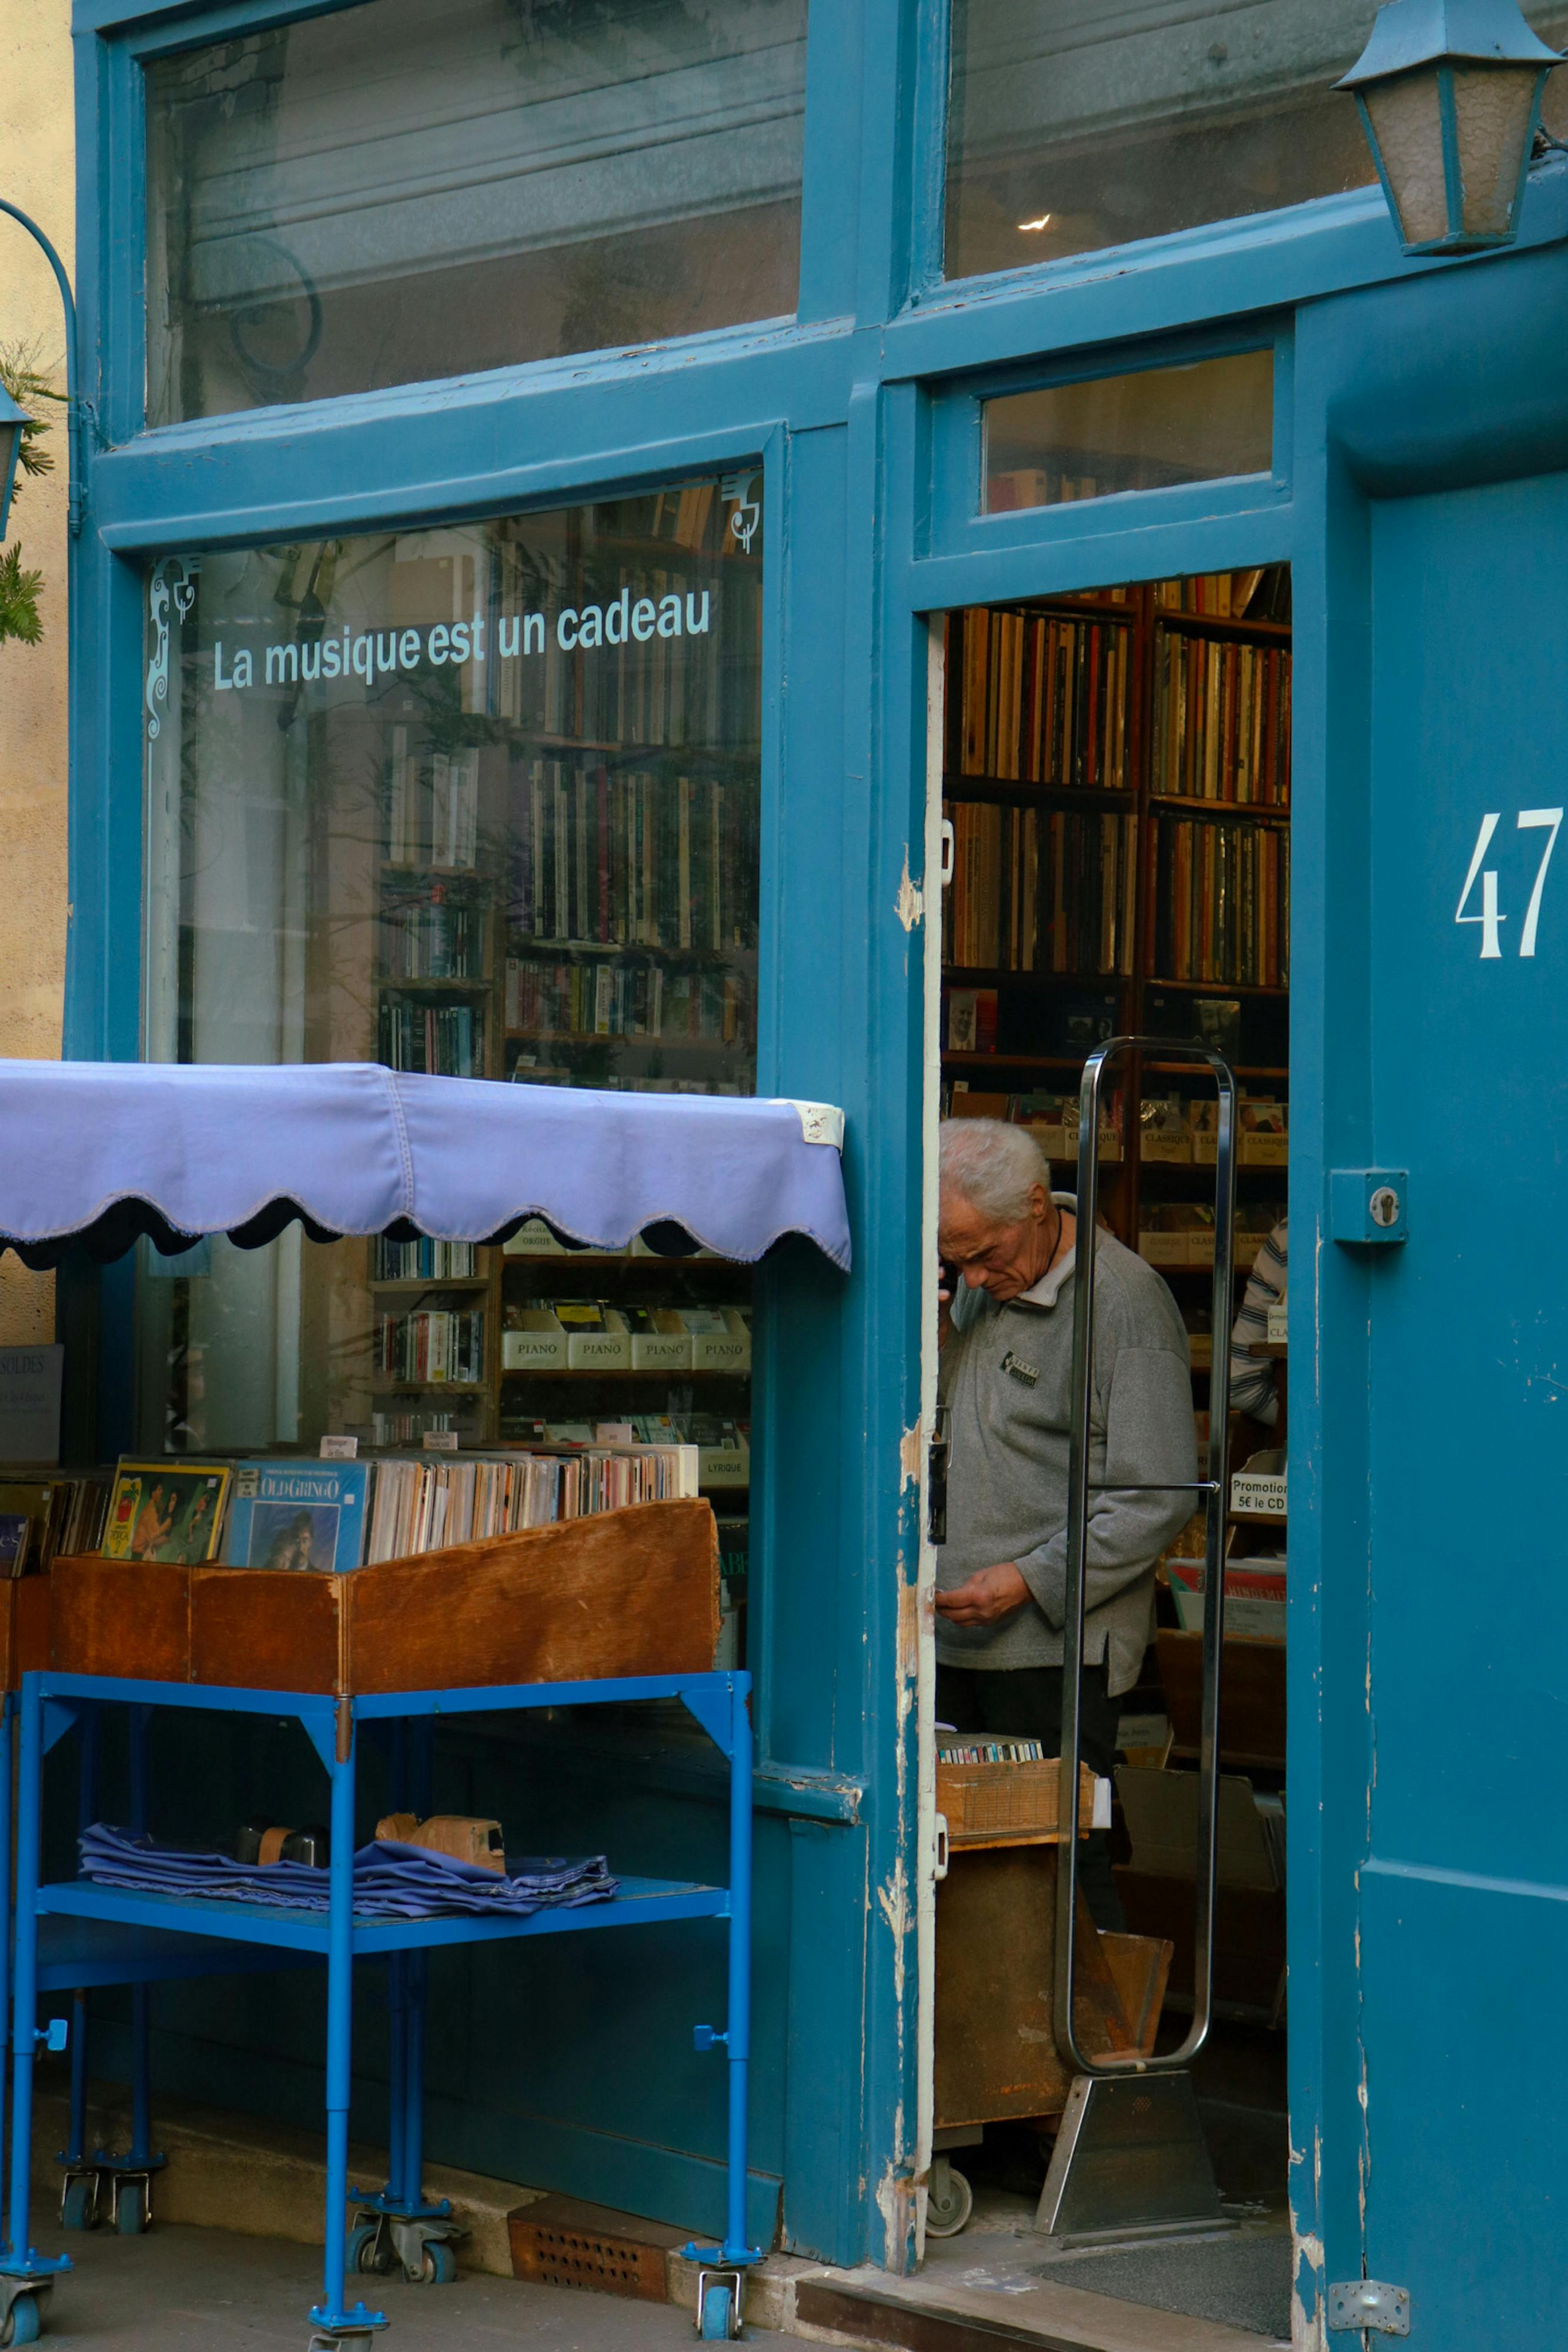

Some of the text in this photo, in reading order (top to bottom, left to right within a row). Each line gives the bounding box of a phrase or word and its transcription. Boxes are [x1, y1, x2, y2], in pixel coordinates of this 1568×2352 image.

[214, 588, 710, 690] La musique est un cadeau
[1455, 807, 1563, 958] 47
[1146, 1134, 1191, 1145] CLASSIQUE
[1247, 1138, 1288, 1148] CLASSIQU
[522, 1237, 550, 1245] ORGUE
[518, 1344, 557, 1355] PIANO
[583, 1344, 621, 1355] PIANO
[646, 1344, 684, 1355] PIANO
[706, 1344, 743, 1355] PIANO
[708, 1464, 742, 1472] LYRIQUE
[262, 1477, 288, 1496] OLD
[289, 1478, 339, 1500] GRINGO
[1239, 1496, 1285, 1509] 5€ le CD
[1228, 1585, 1287, 1601] HINDEMIT
